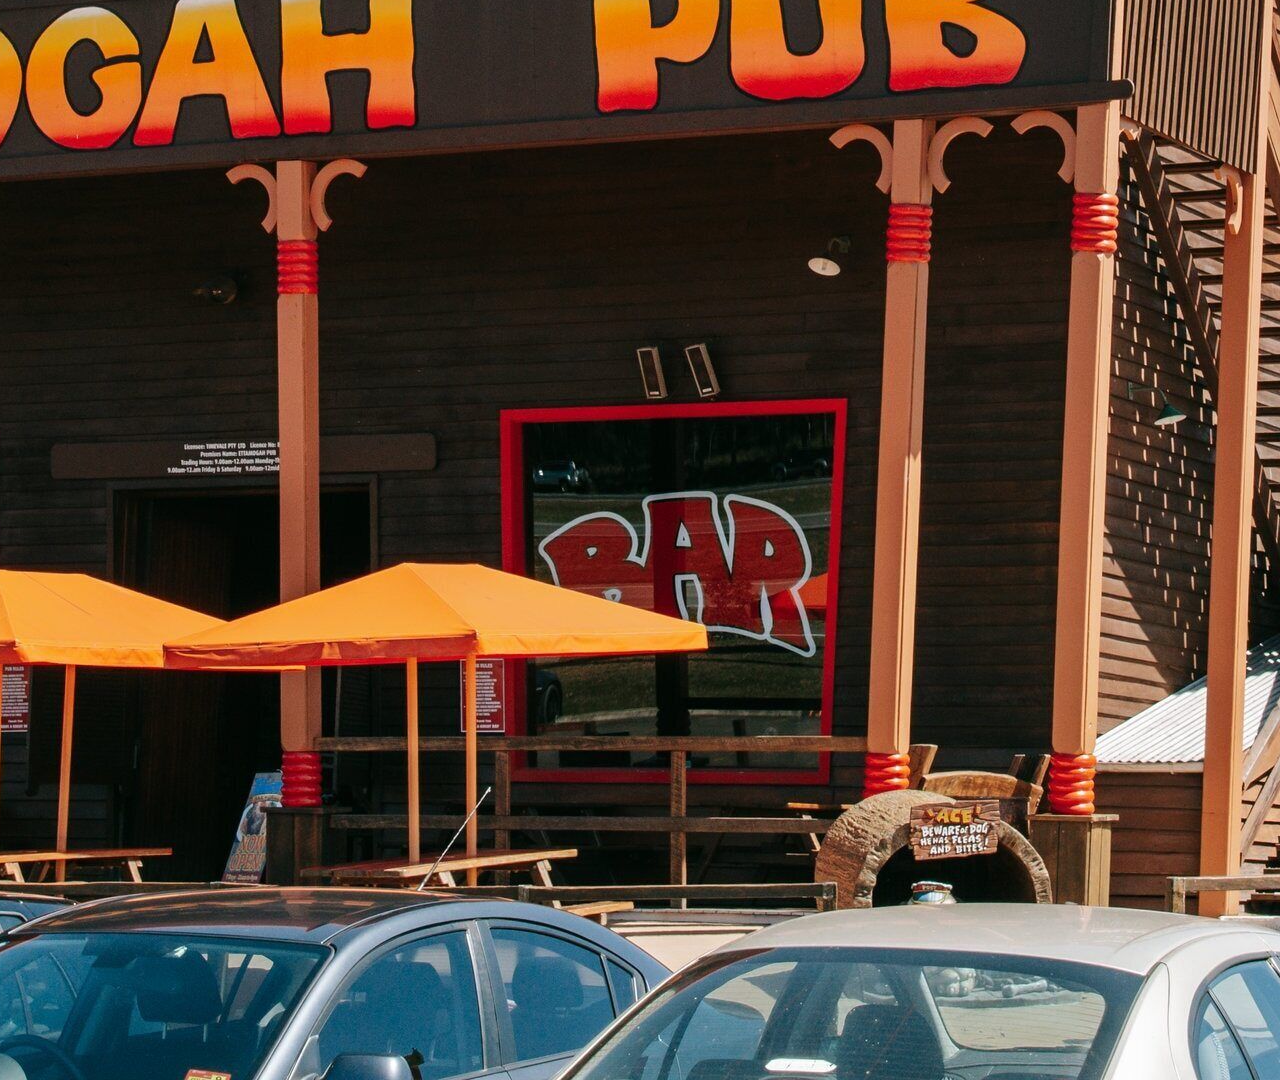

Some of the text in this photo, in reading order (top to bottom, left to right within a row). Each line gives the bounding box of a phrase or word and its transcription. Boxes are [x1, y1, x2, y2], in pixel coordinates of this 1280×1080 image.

[538, 490, 816, 658] BAR
[921, 825, 960, 837] BEWARE
[970, 822, 988, 834] DOG
[920, 837, 931, 846] HE
[952, 834, 981, 844] FLEAS
[930, 845, 951, 855] AND
